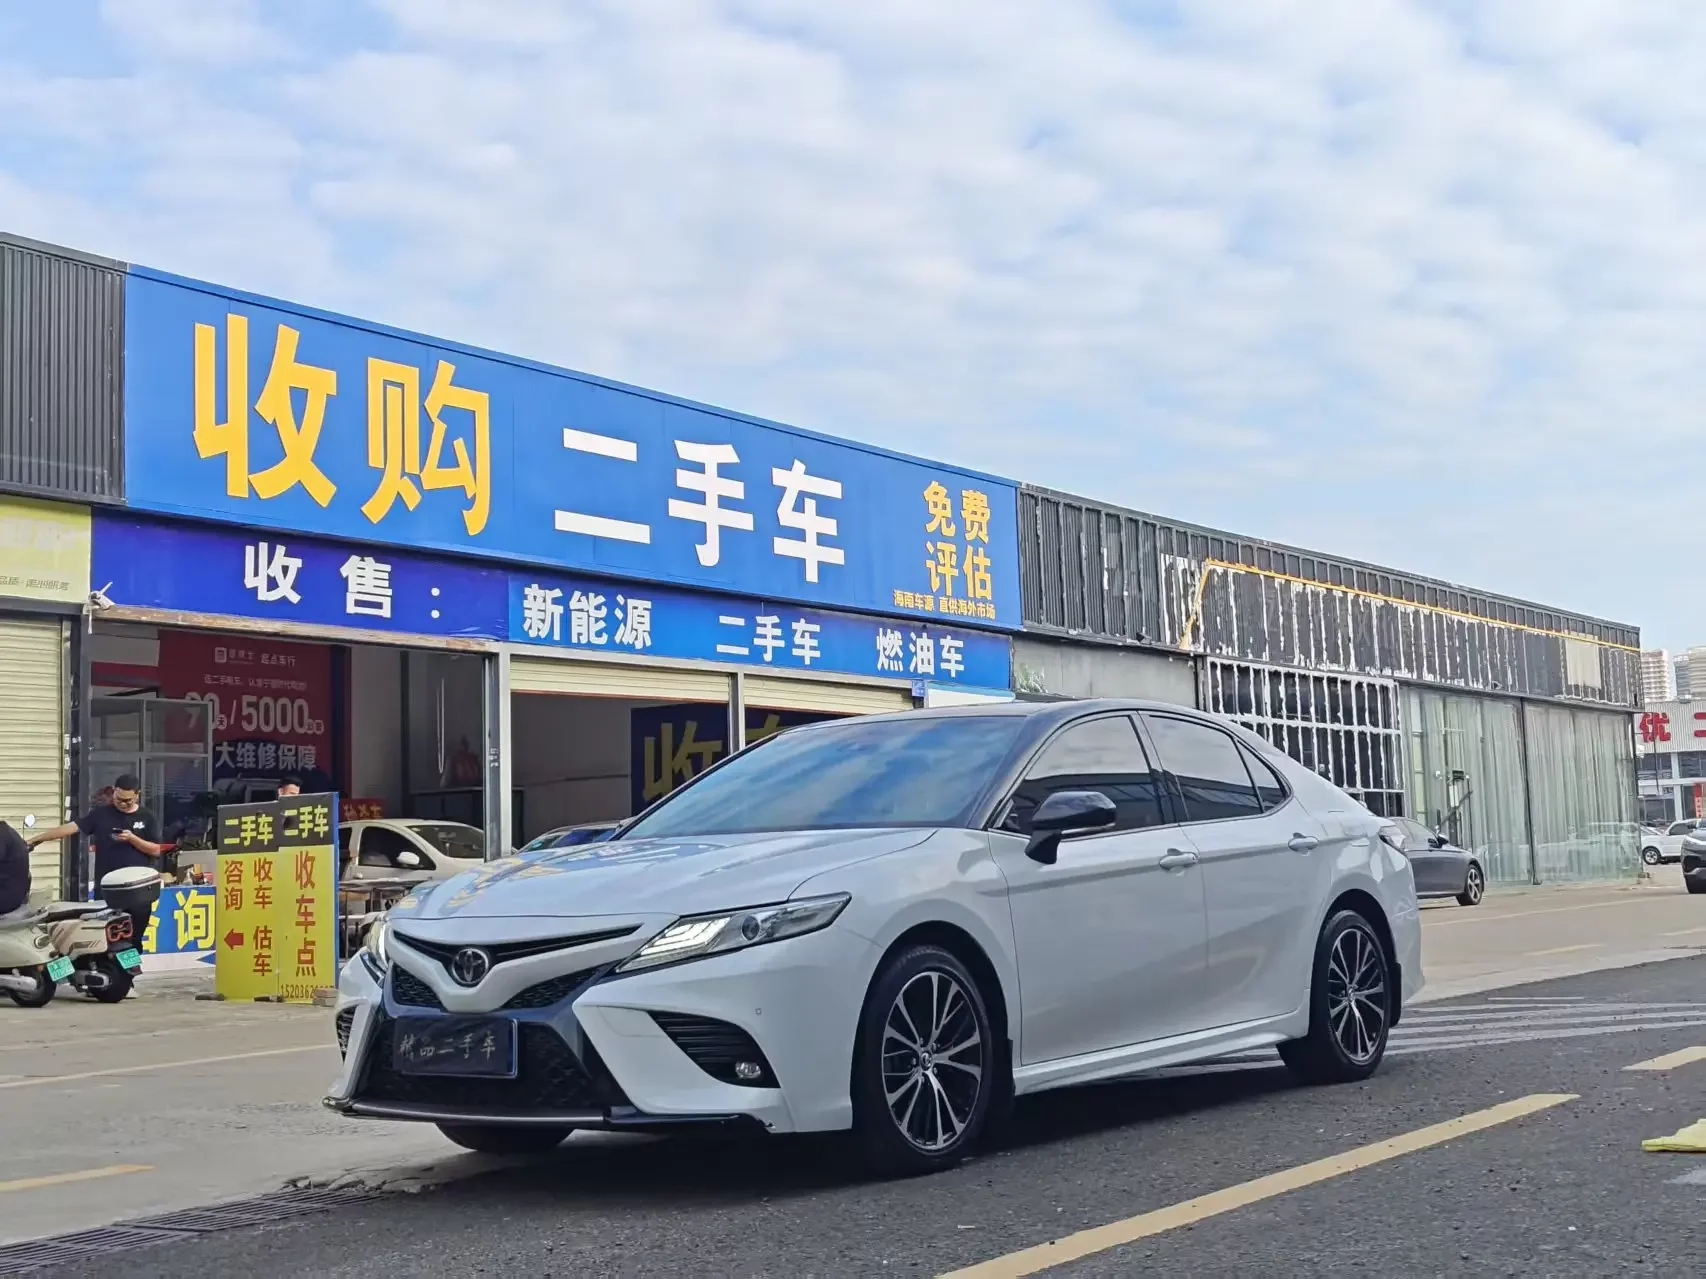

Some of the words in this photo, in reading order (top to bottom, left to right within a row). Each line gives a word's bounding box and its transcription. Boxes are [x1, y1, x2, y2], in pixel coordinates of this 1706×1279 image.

[193, 312, 490, 537] 收购
[554, 428, 845, 584] 二手车
[923, 480, 991, 544] 免费
[925, 540, 992, 601] 评估
[893, 589, 935, 612] 海南车源
[938, 597, 996, 619] 直供海外市场
[522, 583, 653, 650] 新能源
[715, 614, 822, 666] 二手车
[875, 627, 966, 678] 燃油车
[192, 741, 317, 771] 大维修保障
[223, 813, 274, 847] 二手车
[284, 804, 330, 839] 二手车
[224, 859, 244, 911] 咨询
[253, 857, 273, 910] 收车
[295, 850, 317, 978] 收车点
[252, 925, 273, 977] 估车
[281, 984, 334, 1000] 1520362
[398, 1030, 496, 1062] 精品二手车
